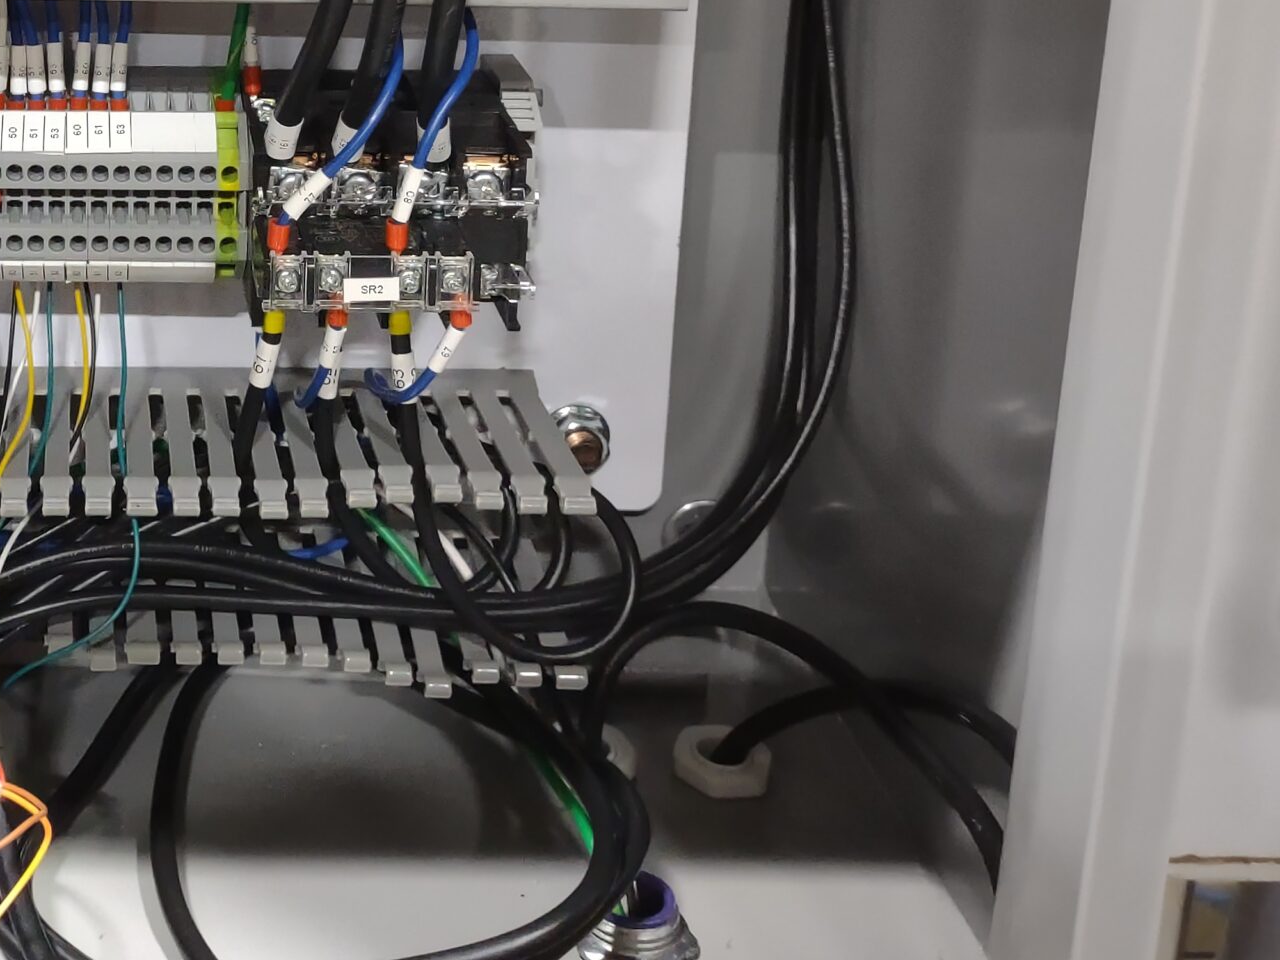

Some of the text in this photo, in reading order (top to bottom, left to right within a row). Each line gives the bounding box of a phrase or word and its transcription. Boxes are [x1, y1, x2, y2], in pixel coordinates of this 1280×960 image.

[8, 126, 18, 139] 50
[29, 128, 38, 139] 51
[50, 127, 59, 139] 53
[73, 124, 82, 136] 60
[94, 124, 103, 135] 61
[116, 123, 125, 135] 63
[360, 285, 384, 295] SR2
[440, 346, 452, 358] 67
[393, 369, 405, 388] 63
